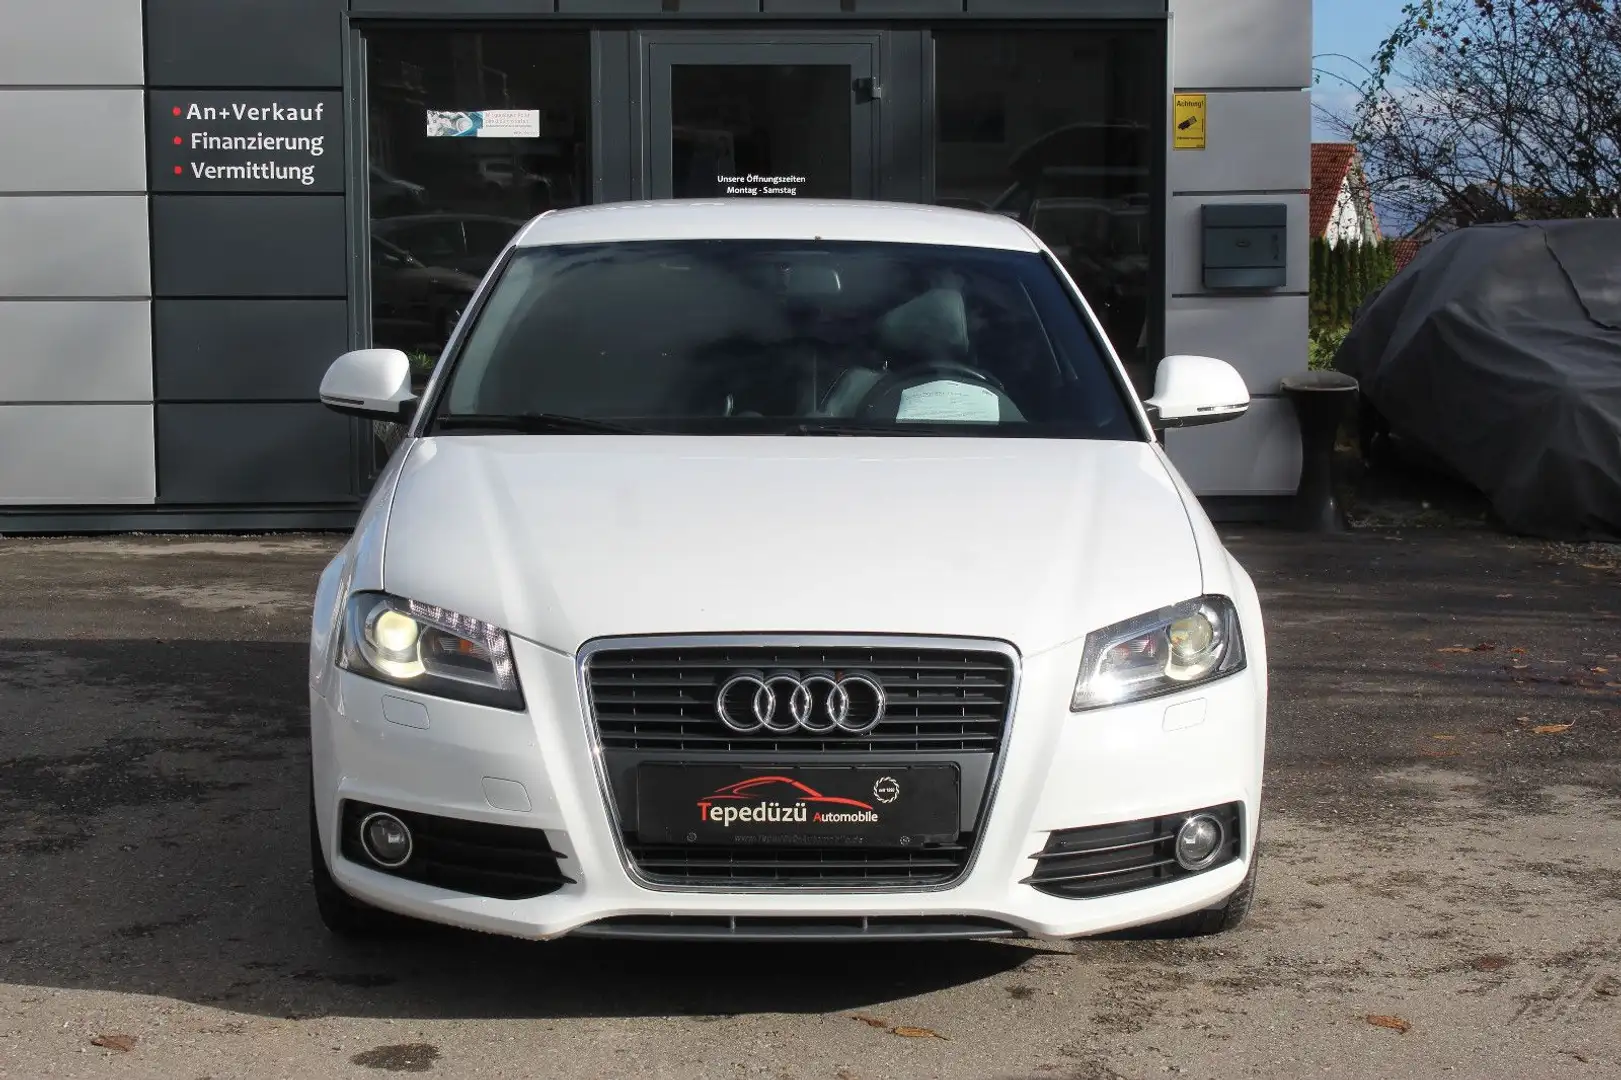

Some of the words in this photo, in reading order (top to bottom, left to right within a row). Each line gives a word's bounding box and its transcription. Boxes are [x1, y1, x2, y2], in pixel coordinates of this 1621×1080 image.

[186, 102, 324, 121] An+Verkauf
[1176, 100, 1203, 108] Achtung!
[191, 131, 325, 156] Finanzierung
[190, 161, 316, 186] Vermittlung
[717, 175, 745, 183] Unsere
[746, 173, 806, 184] Öffnungszeiten
[726, 186, 758, 196] Montag
[762, 186, 797, 196] Samstag
[697, 801, 808, 827] Tepedüzü
[813, 811, 879, 823] Automobile
